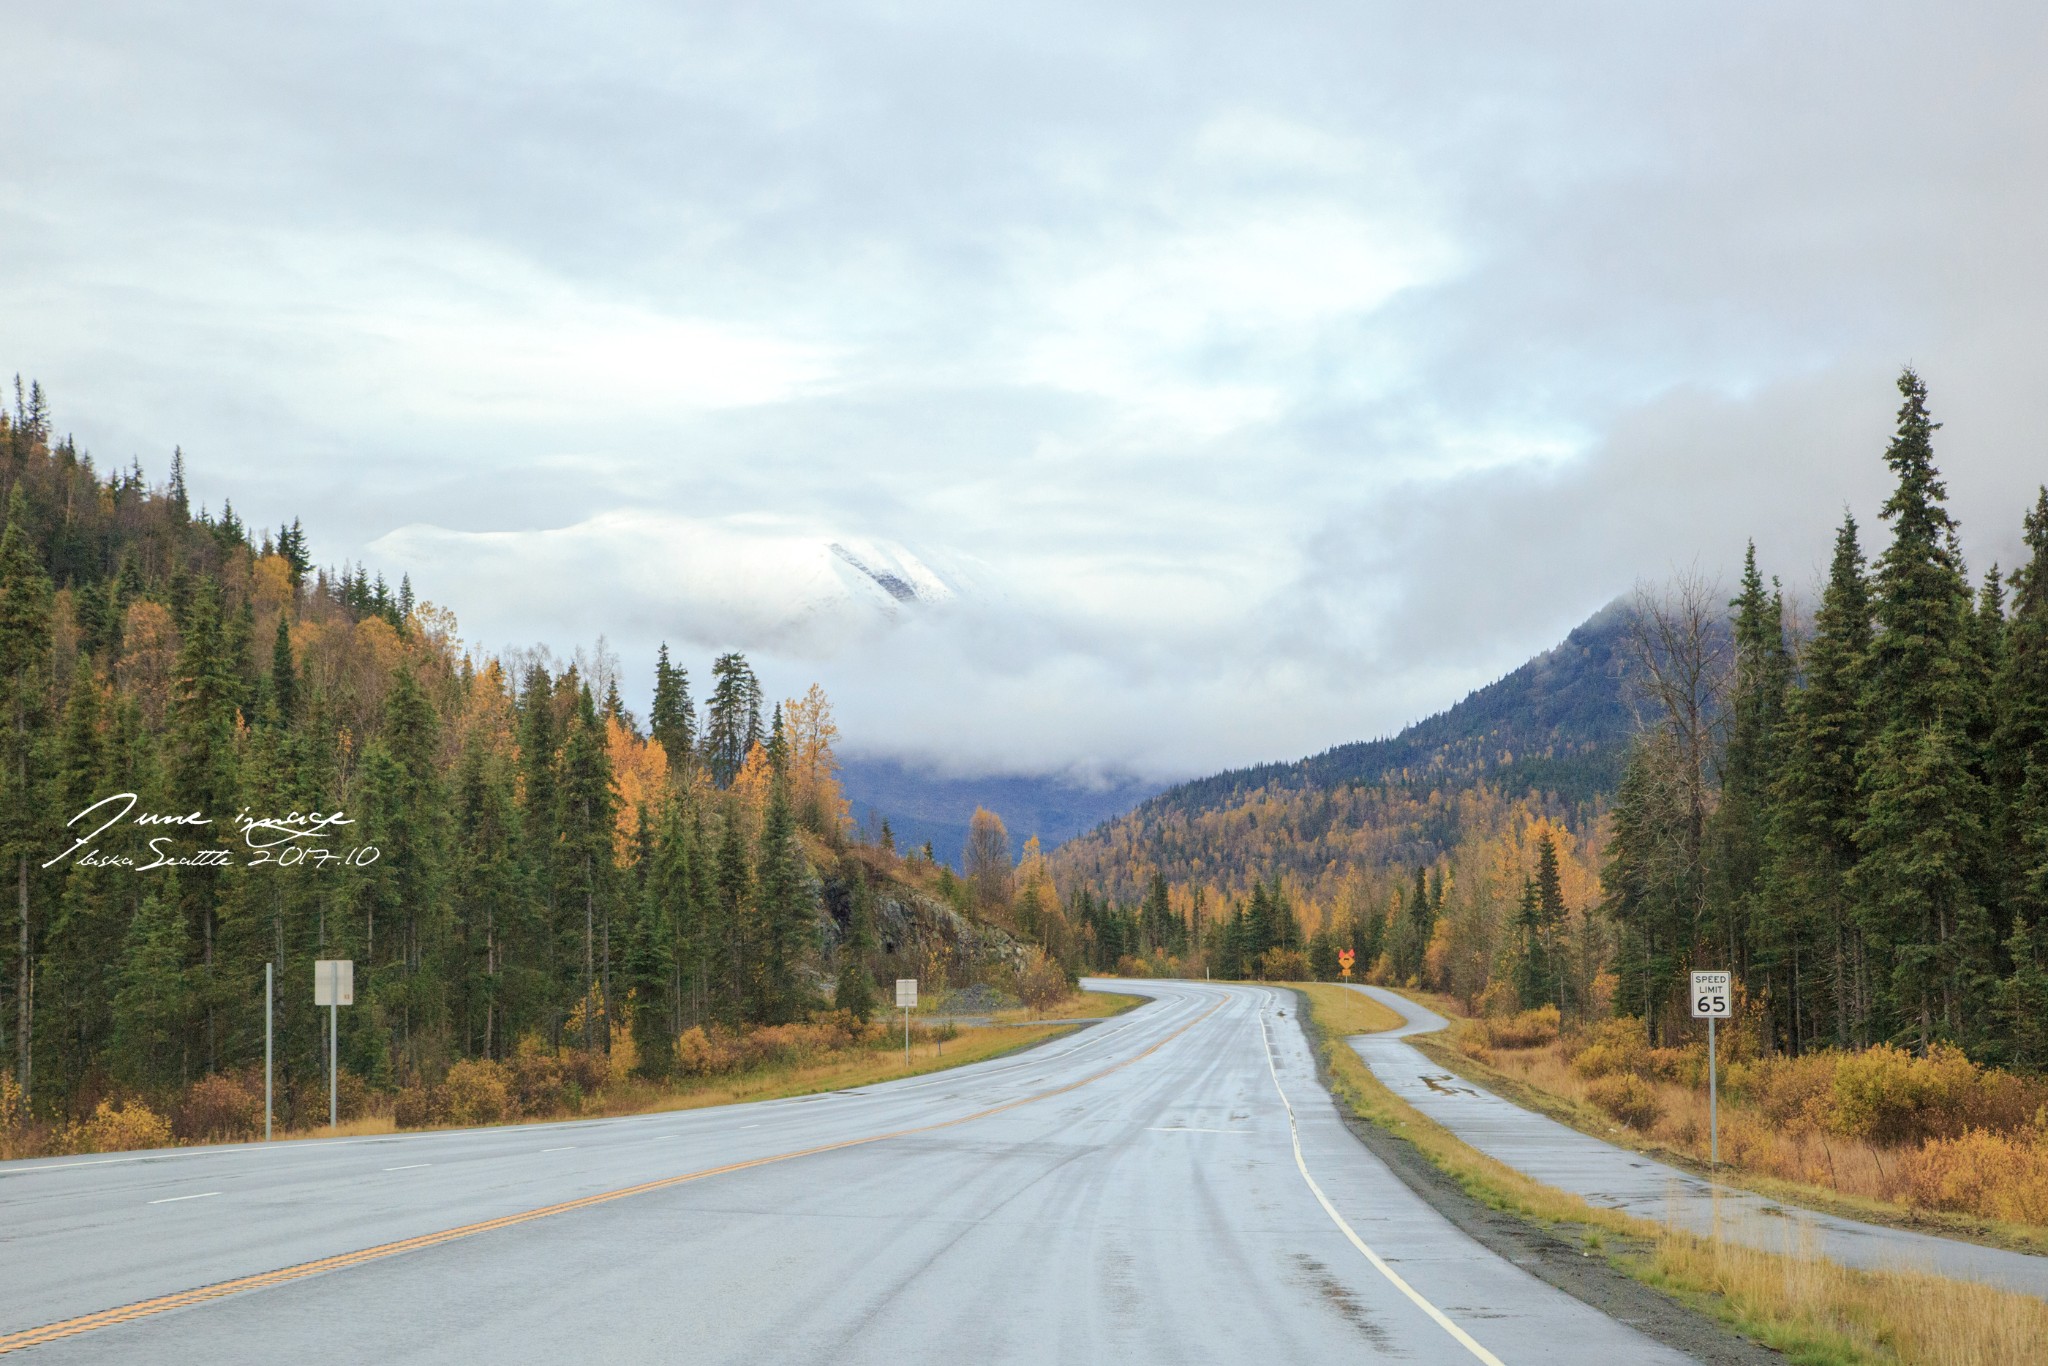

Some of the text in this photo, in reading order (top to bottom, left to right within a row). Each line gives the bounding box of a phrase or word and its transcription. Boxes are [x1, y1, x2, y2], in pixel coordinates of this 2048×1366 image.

[1695, 975, 1727, 984] SPEED
[1699, 986, 1723, 994] LIMIT
[1697, 996, 1726, 1013] 65
